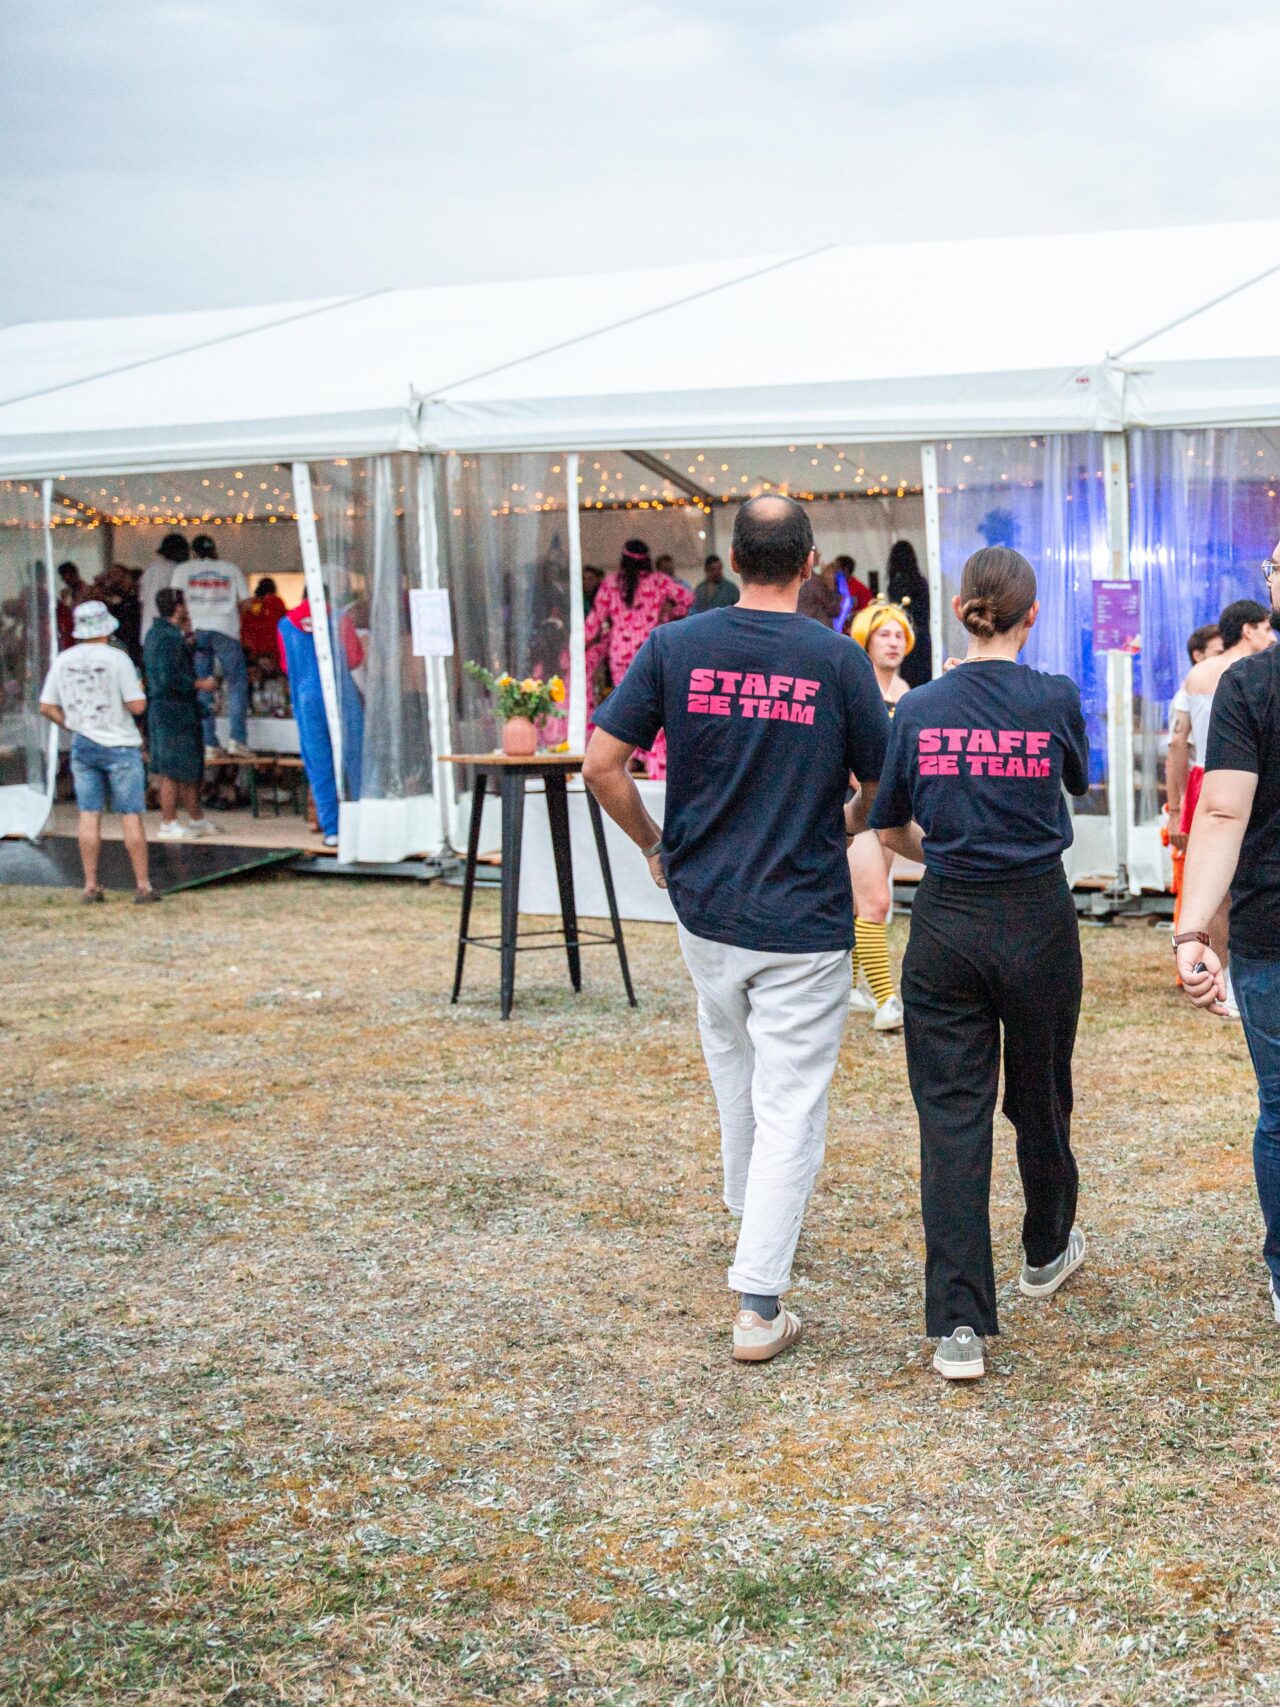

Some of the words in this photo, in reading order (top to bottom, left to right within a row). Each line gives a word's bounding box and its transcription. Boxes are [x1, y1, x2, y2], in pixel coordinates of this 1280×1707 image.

[689, 668, 821, 701] STAFF
[687, 693, 731, 716] ZE
[738, 697, 816, 725] TEAM
[918, 728, 1051, 754] STAFF
[918, 754, 960, 776] ZE
[965, 755, 1051, 778] TEAM
